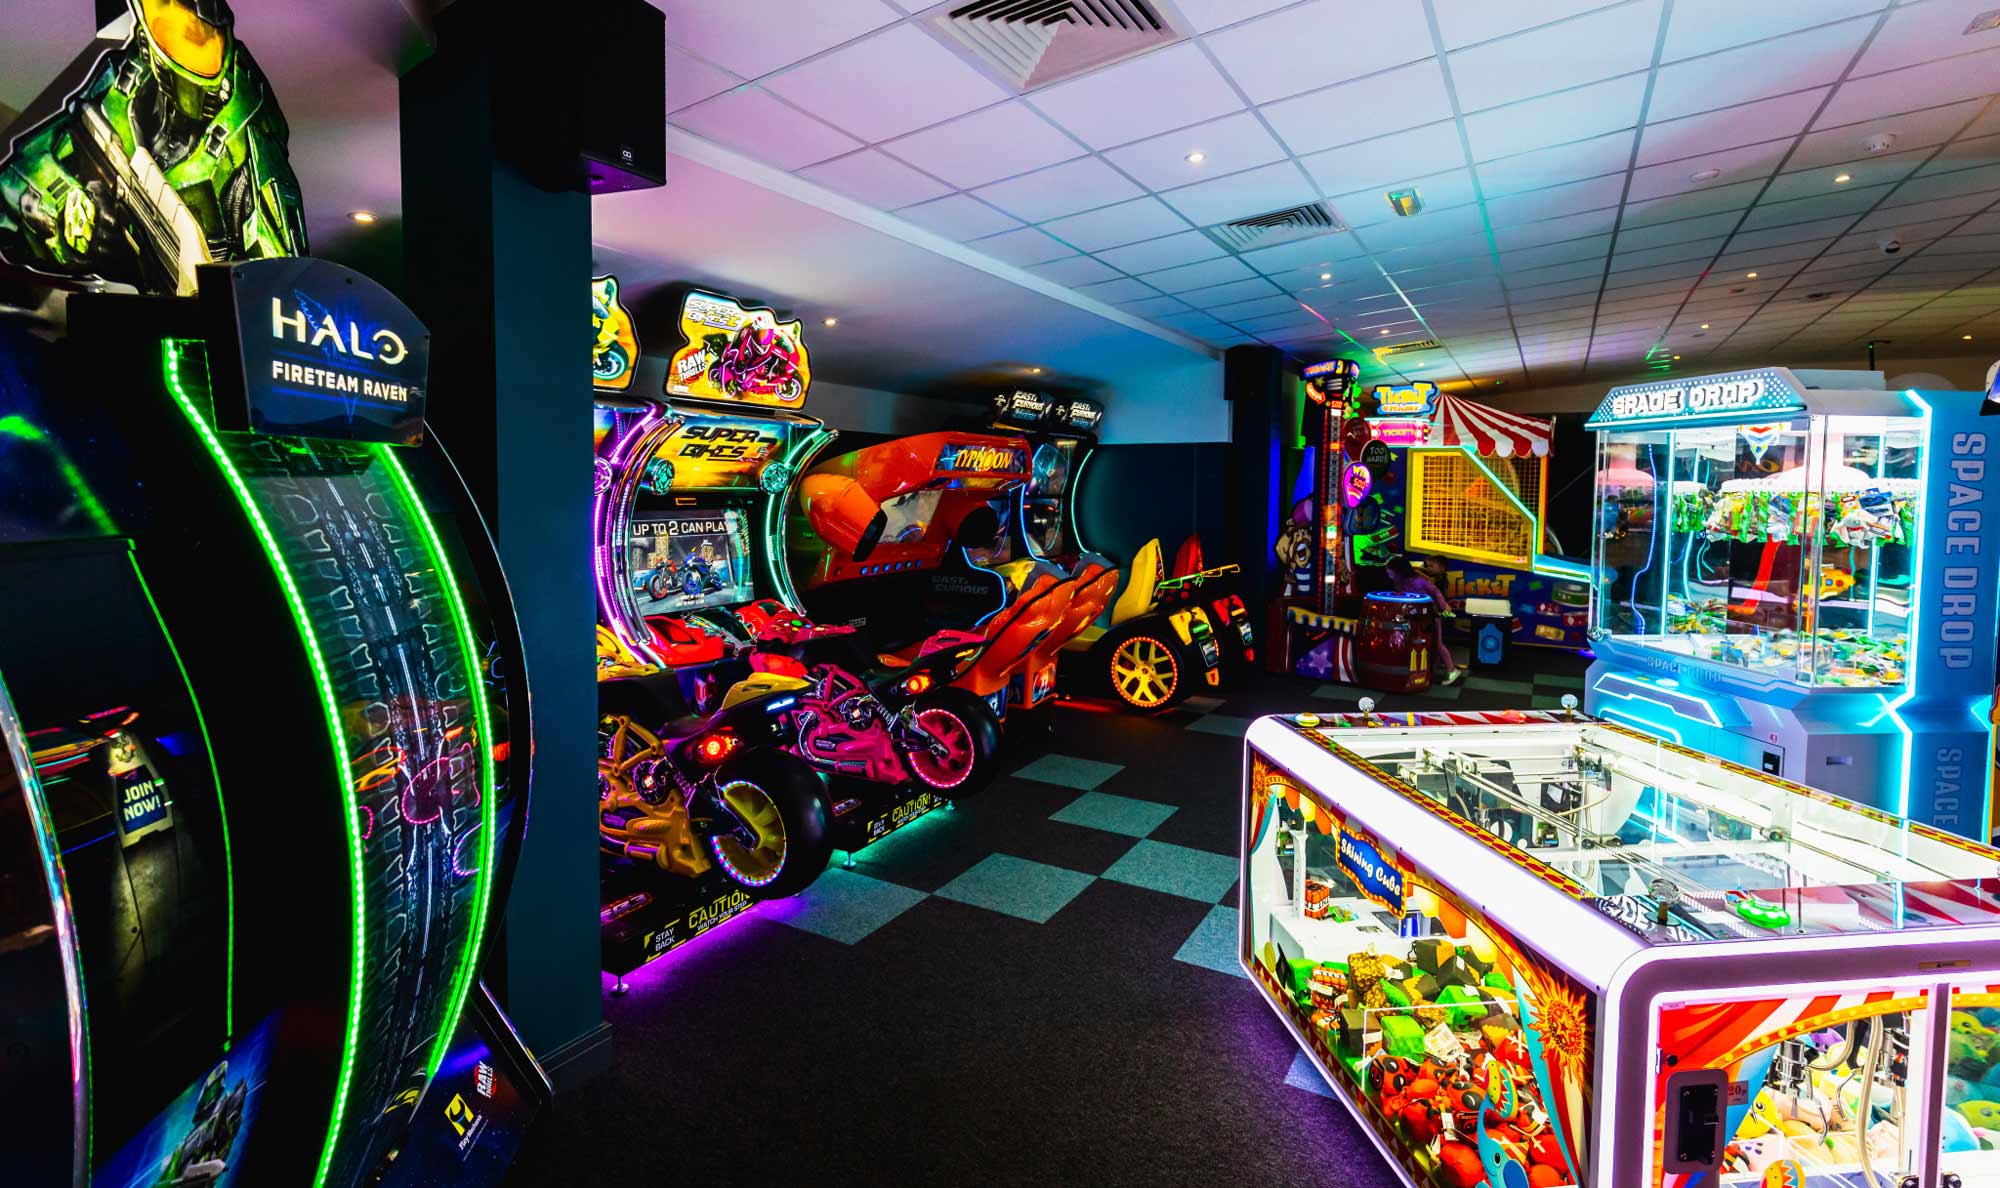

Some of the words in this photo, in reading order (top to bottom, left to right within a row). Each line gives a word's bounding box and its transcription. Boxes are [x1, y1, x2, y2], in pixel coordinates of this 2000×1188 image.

[272, 296, 408, 365] HALO
[677, 348, 706, 374] RAW
[679, 362, 707, 382] THRILLS
[272, 360, 359, 393] FIRETEAM
[363, 378, 407, 402] RAVEN
[680, 425, 760, 442] SUPER
[680, 443, 749, 458] BIKES
[954, 447, 1014, 472] TYPHOON
[1369, 446, 1385, 455] TOO
[1945, 432, 1986, 555] SPACE
[633, 524, 649, 536] UP
[652, 523, 667, 535] TO
[669, 520, 679, 535] 2
[682, 522, 704, 534] CAN
[1940, 566, 1978, 669] DROP
[123, 780, 154, 803] JOIN
[1933, 748, 1962, 825] SPACE
[123, 795, 161, 821] NOW!
[1341, 838, 1373, 878] Shining
[1375, 866, 1400, 896] Cube
[697, 917, 718, 930] WATCH
[719, 909, 734, 919] YOUR
[734, 900, 747, 911] STEP
[655, 927, 675, 943] STAY
[655, 936, 675, 952] BACK
[477, 1060, 488, 1096] RAW
